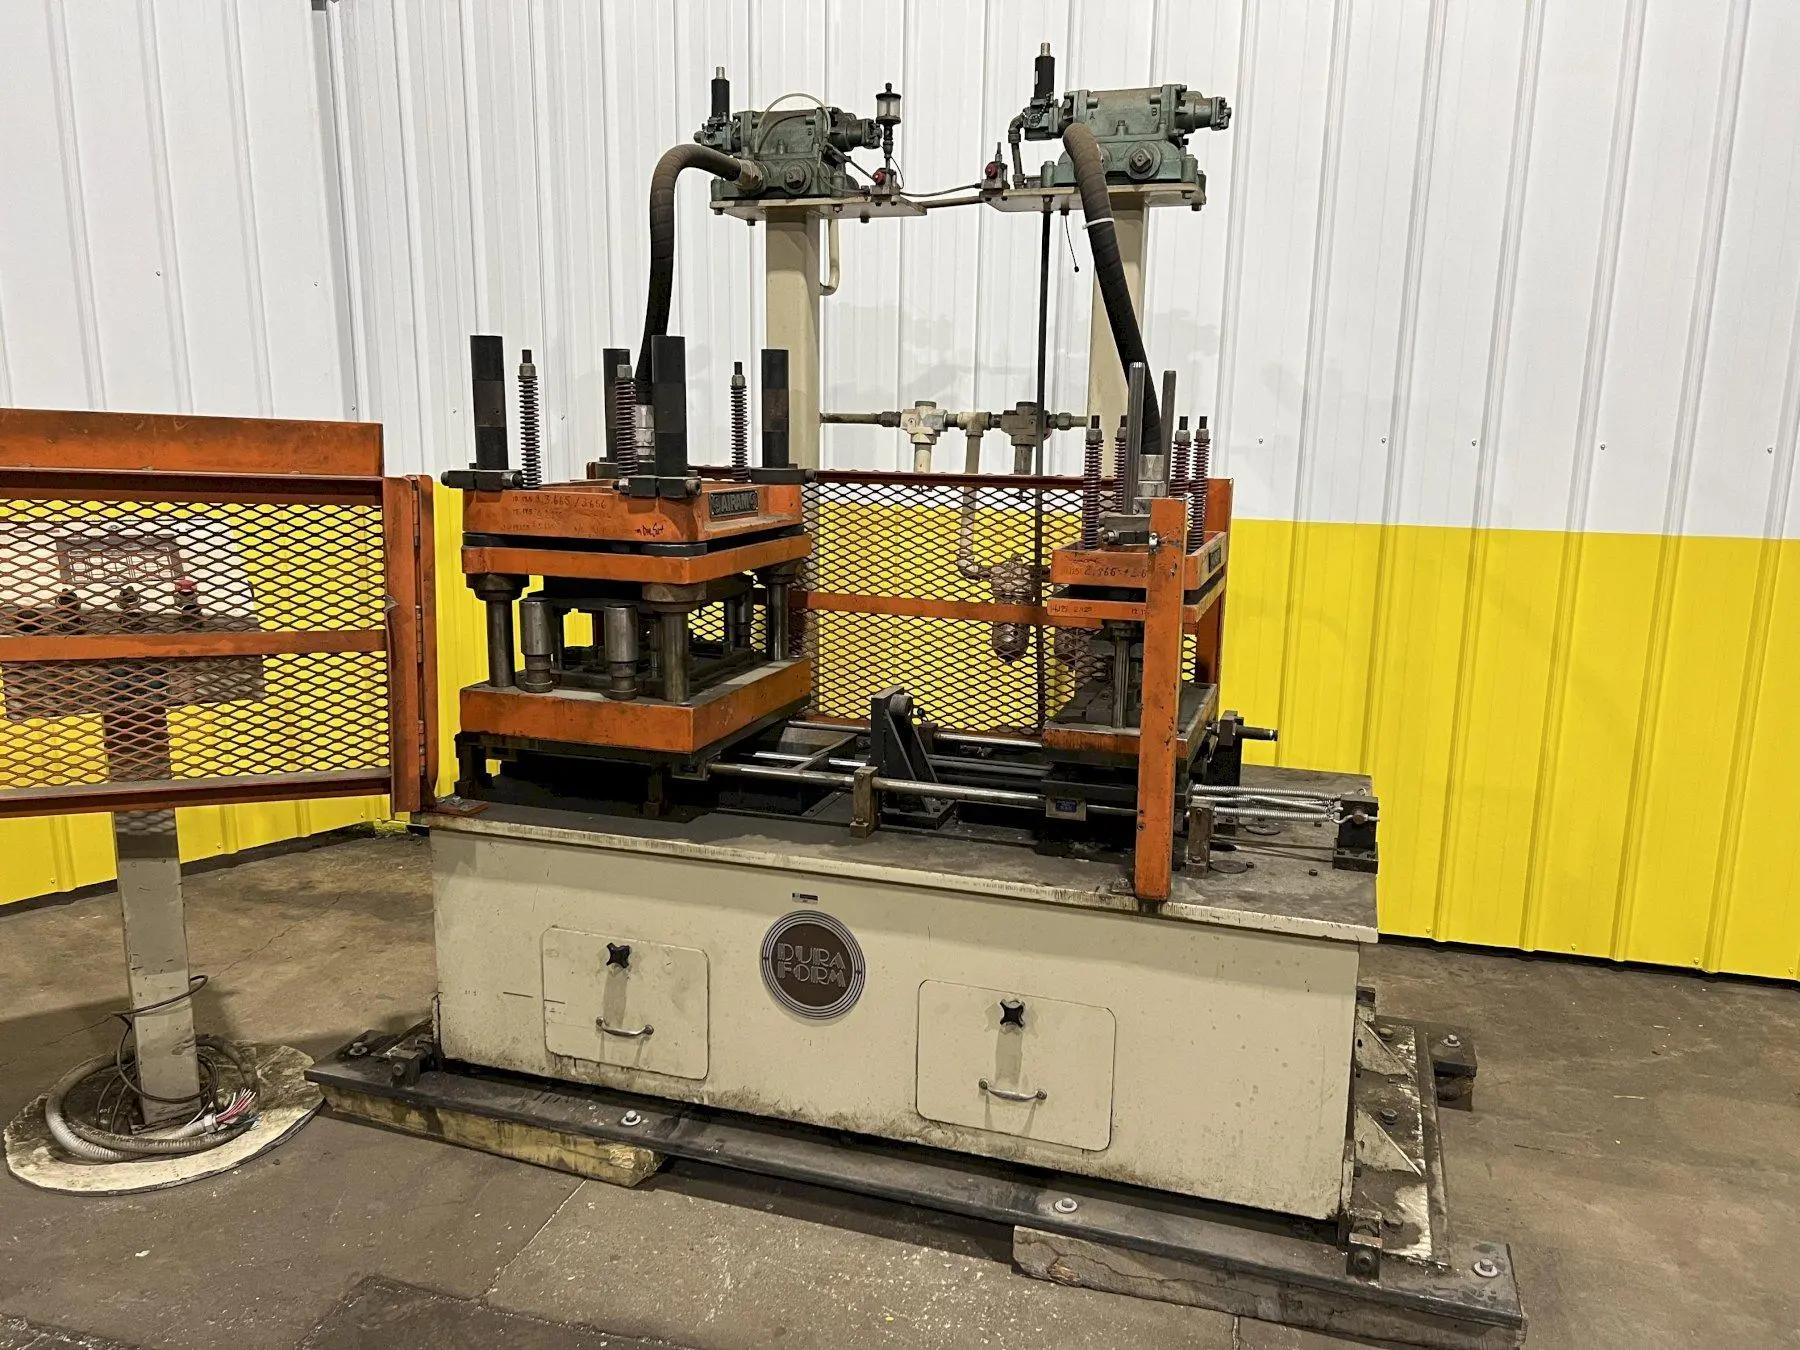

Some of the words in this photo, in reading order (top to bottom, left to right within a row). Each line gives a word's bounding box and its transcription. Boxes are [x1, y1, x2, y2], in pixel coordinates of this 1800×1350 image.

[1151, 107, 1158, 117] B
[777, 942, 847, 970] DURA
[777, 961, 847, 988] FORM
